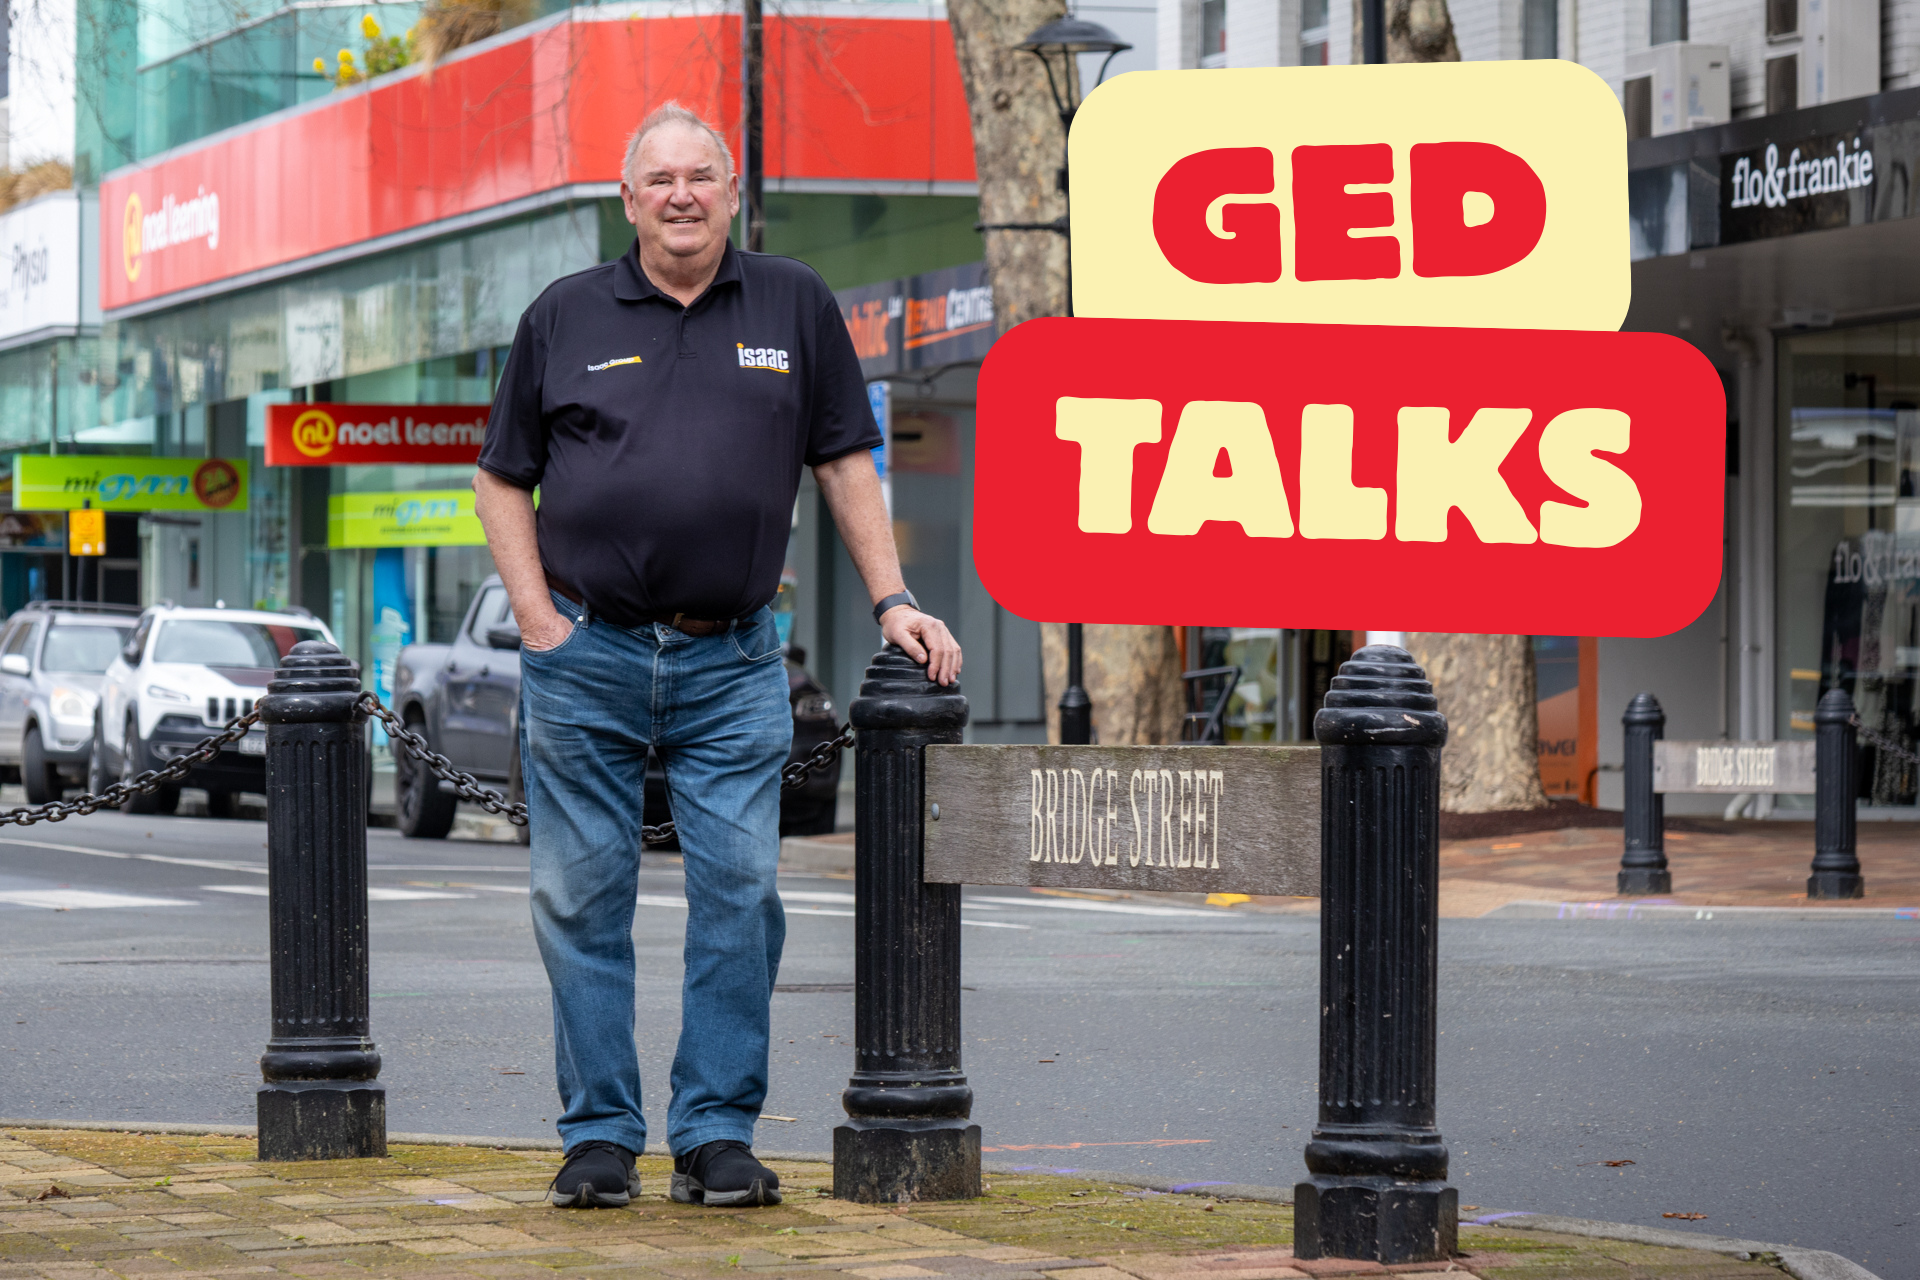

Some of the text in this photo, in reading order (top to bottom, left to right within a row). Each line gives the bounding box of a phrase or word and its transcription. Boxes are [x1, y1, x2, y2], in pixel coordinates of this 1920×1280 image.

[1731, 136, 1873, 208] flo&frankie
[11, 243, 48, 300] Physio
[587, 357, 635, 372] Isaac Group
[737, 343, 789, 371] isaac
[338, 416, 486, 446] noel leemi
[1833, 529, 1920, 586] flo&fra
[1696, 747, 1775, 786] BRIDGE STREET
[1029, 767, 1224, 869] BRIDGE STREET
